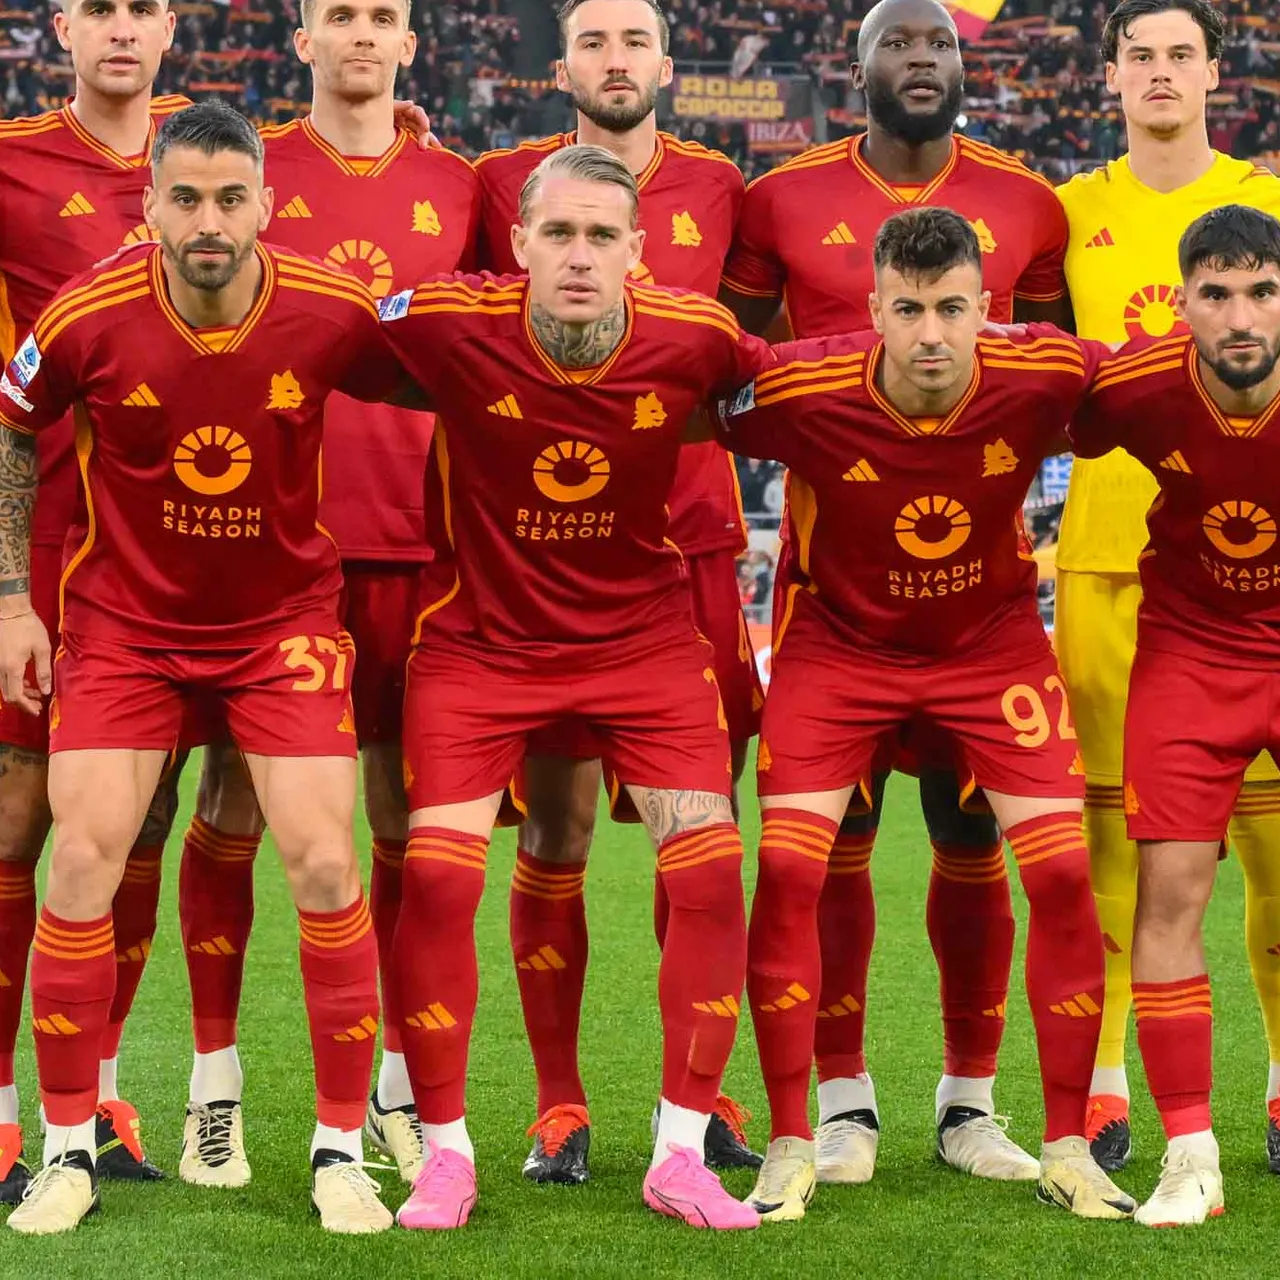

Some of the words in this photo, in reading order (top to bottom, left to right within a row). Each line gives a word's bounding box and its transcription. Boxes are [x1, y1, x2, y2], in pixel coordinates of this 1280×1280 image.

[680, 77, 778, 99] ROMA
[749, 122, 809, 141] IBIZA
[163, 500, 261, 521] RIYADH
[517, 508, 615, 524] RIYADH
[163, 516, 260, 538] SEASON
[515, 525, 612, 540] SEASON
[888, 558, 982, 583] RIYADH
[888, 573, 982, 598] SEASON
[279, 635, 346, 692] 37
[1001, 674, 1077, 748] 92
